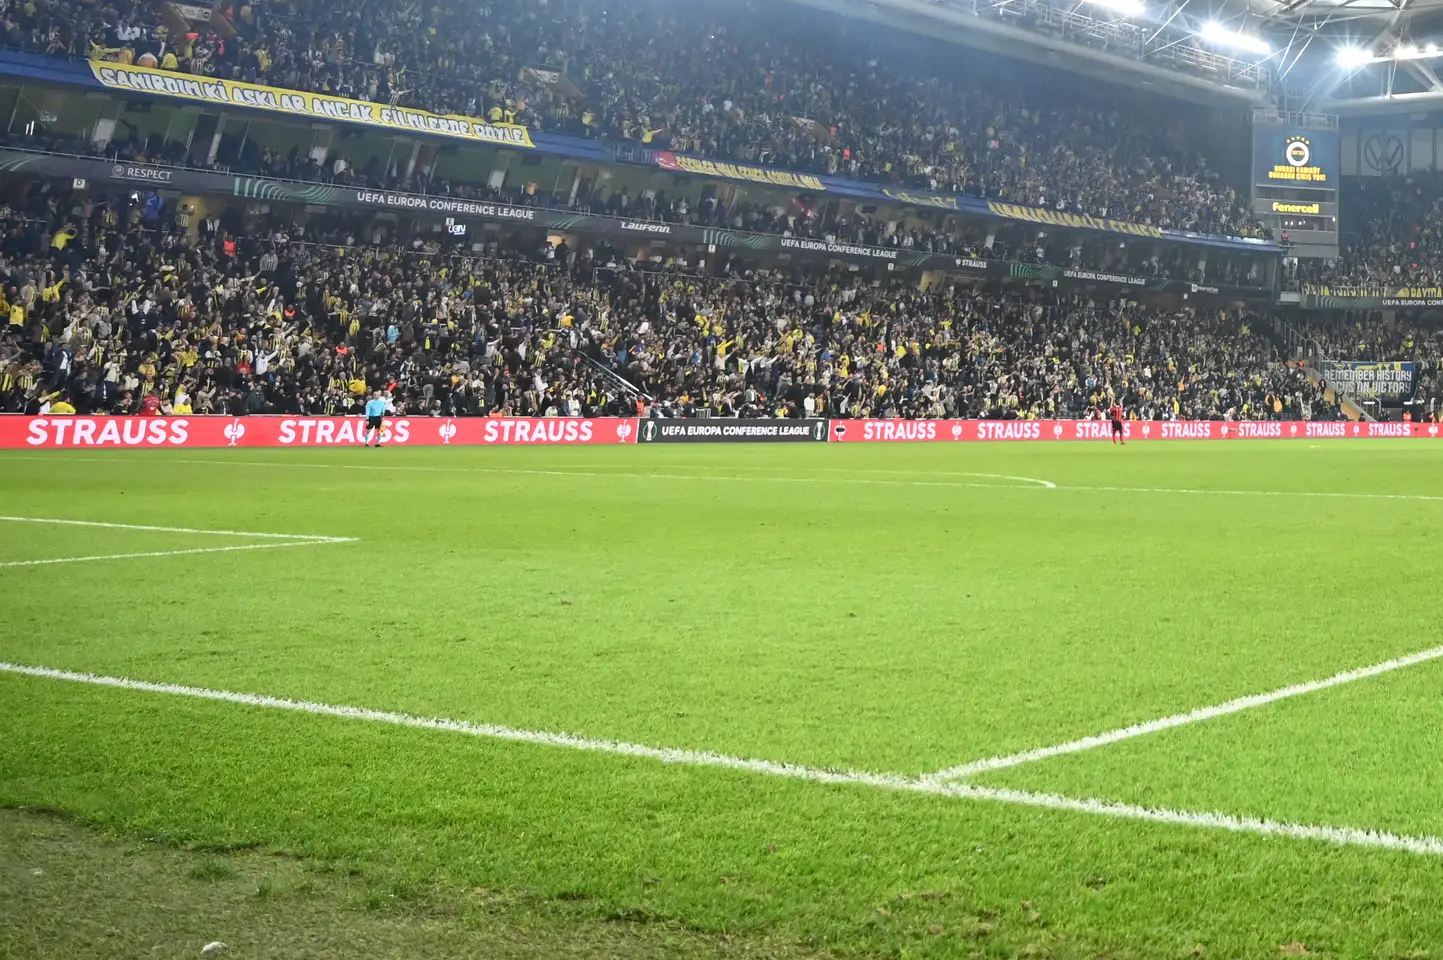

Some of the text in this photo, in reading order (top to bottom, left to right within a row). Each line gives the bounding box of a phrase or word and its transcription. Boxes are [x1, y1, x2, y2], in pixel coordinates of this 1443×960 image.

[312, 98, 377, 121] ANCAK
[127, 167, 172, 181] RESPECT
[357, 192, 535, 220] UEFA EUROPA CONFERENCE LEAGUE
[1272, 201, 1320, 214] Fenercell
[781, 238, 897, 259] UEFA EUROPA CONFERENCE LEAGUE
[961, 258, 987, 269] STRAUSS
[1063, 270, 1146, 286] UEFA EUROPA CONFERENCE LEAGUE
[1324, 369, 1412, 381] REMEMBER HISTORY
[1357, 381, 1370, 392] ON
[1372, 381, 1411, 393] VICTORY
[27, 419, 189, 444] STRAUSS
[484, 420, 593, 442] STRAUSS
[662, 426, 810, 436] UEFA EUROPA CONFERENCE LEAGUE
[863, 422, 936, 440] STRAUSS
[977, 422, 1040, 439] STRAUSS
[1161, 423, 1211, 438] STRAUSS
[1238, 423, 1281, 437] STRAUSS
[1306, 423, 1345, 437] STRAUSS
[1368, 423, 1411, 436] STRAUSS
